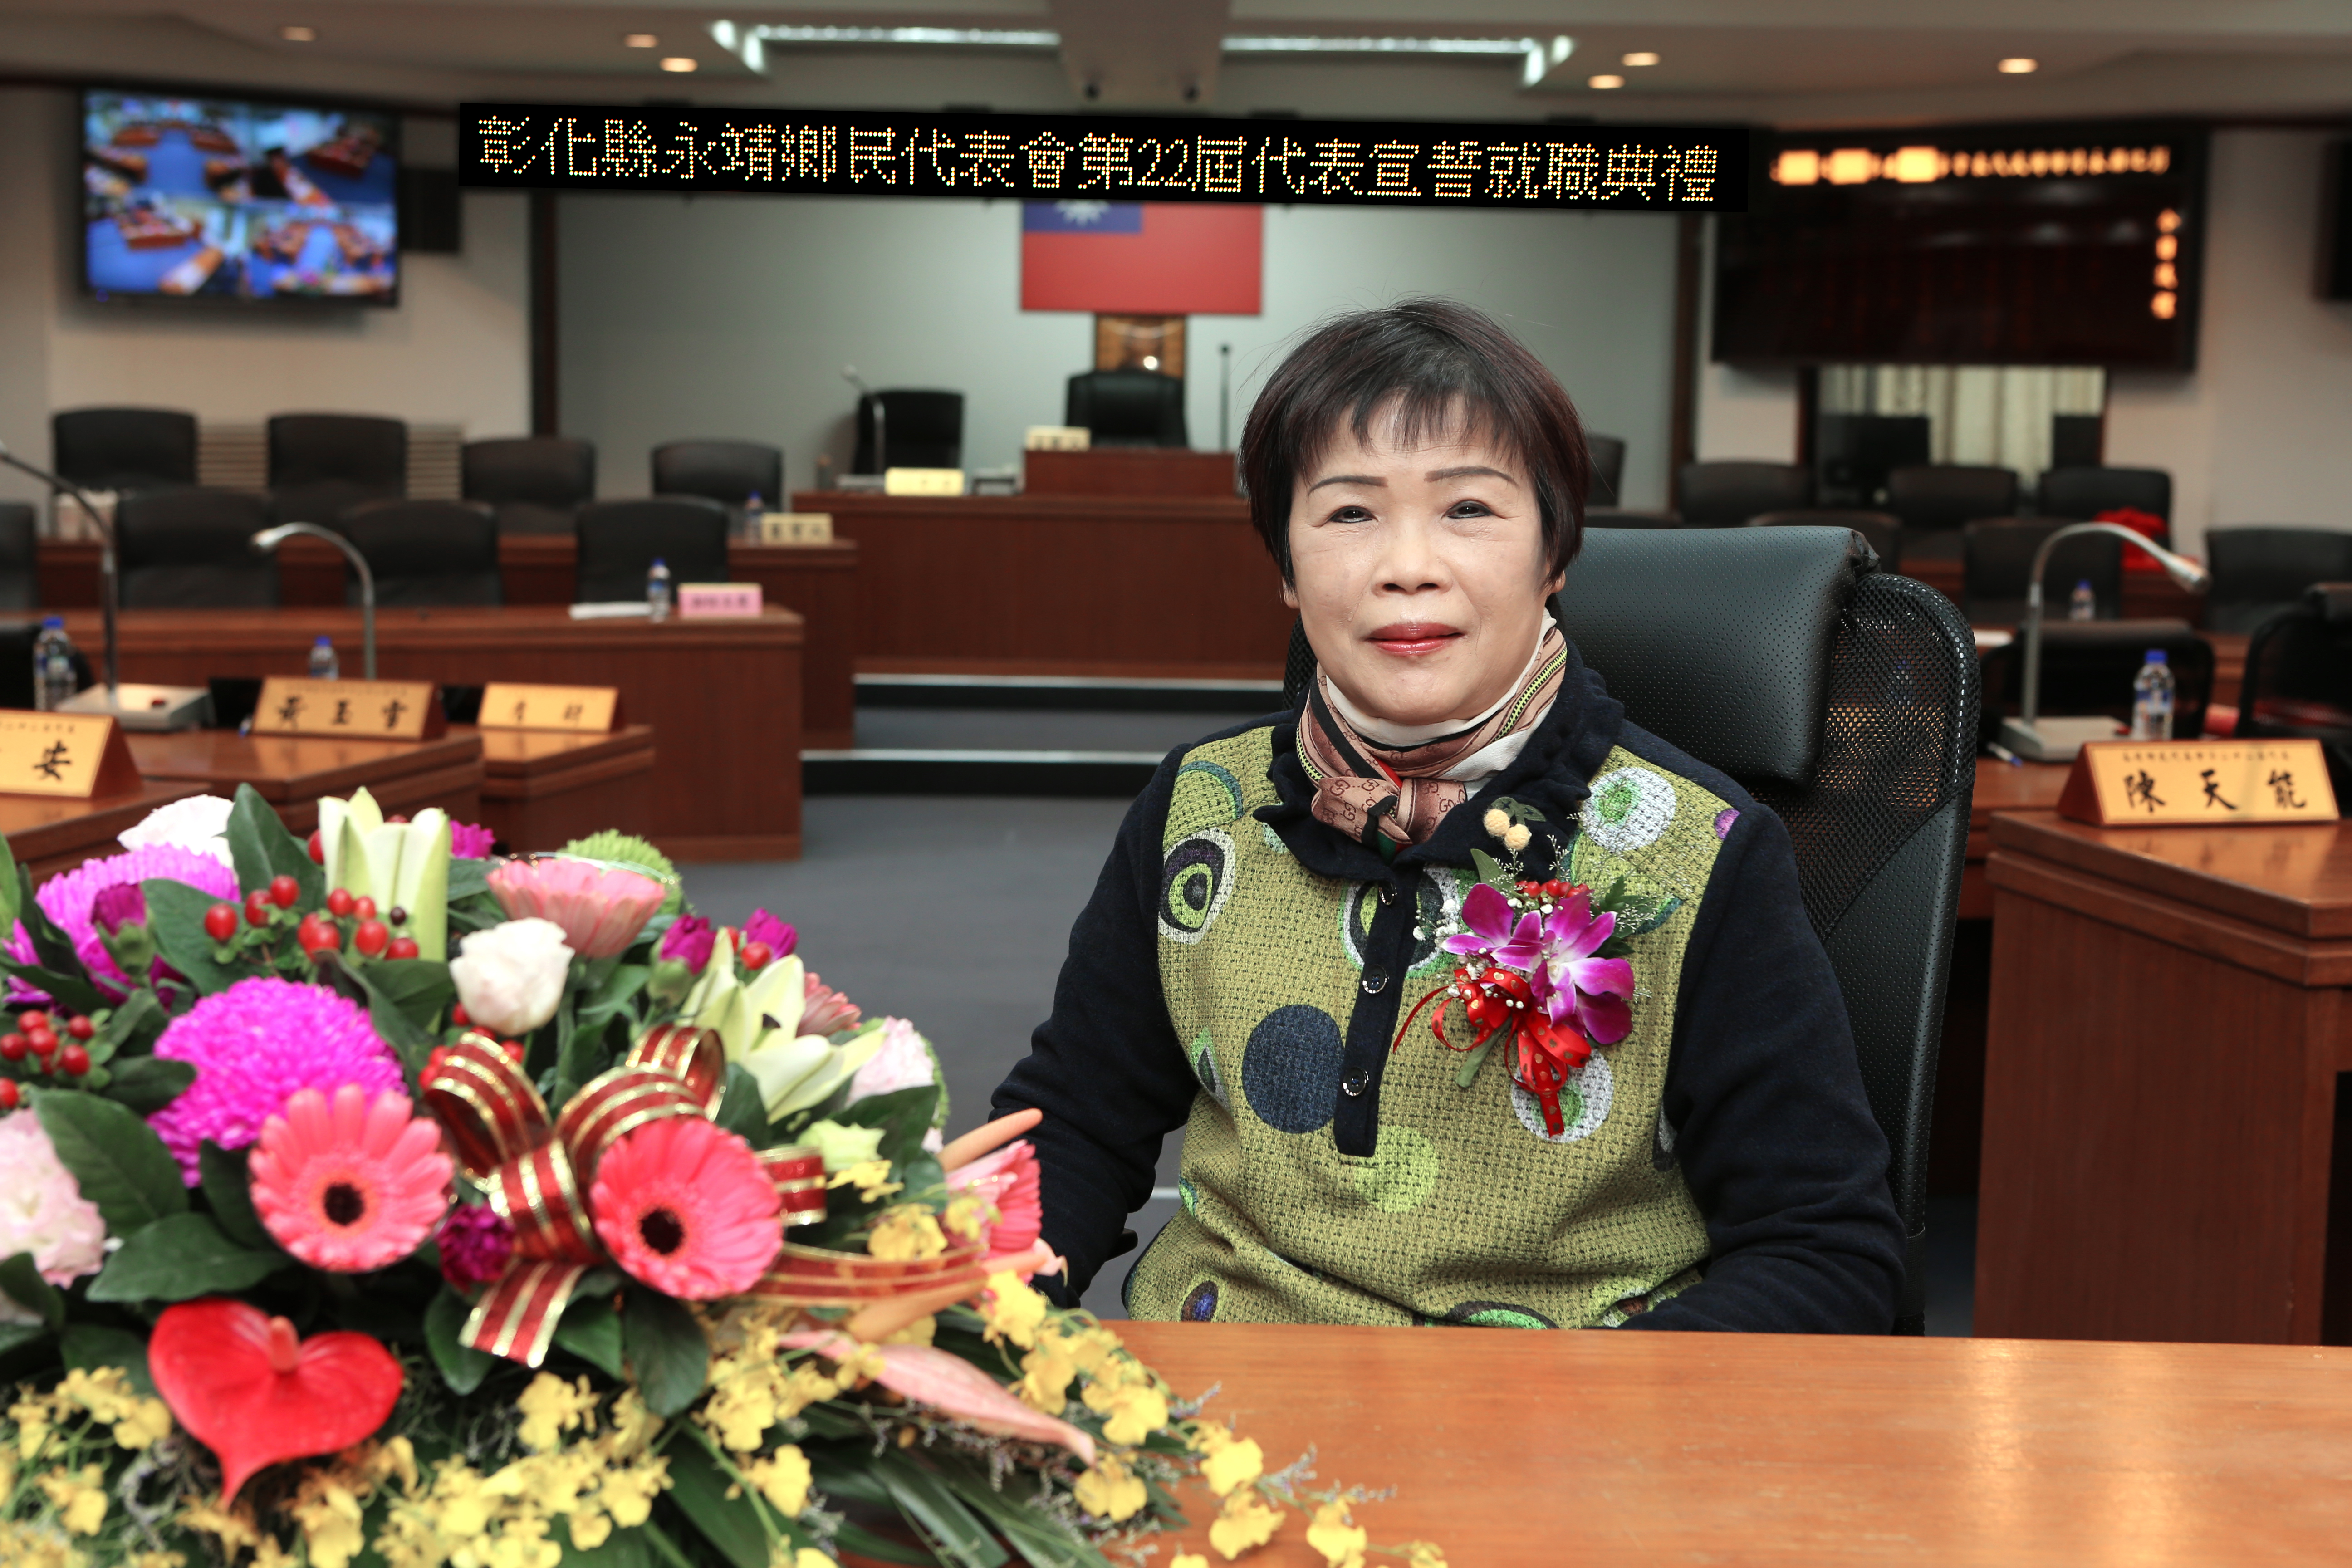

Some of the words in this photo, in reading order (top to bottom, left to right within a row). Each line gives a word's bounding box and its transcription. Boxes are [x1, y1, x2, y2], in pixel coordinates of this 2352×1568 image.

[478, 115, 1718, 202] 彰化縣永靖鄉民代表會第22屆代表宣誓就職典禮
